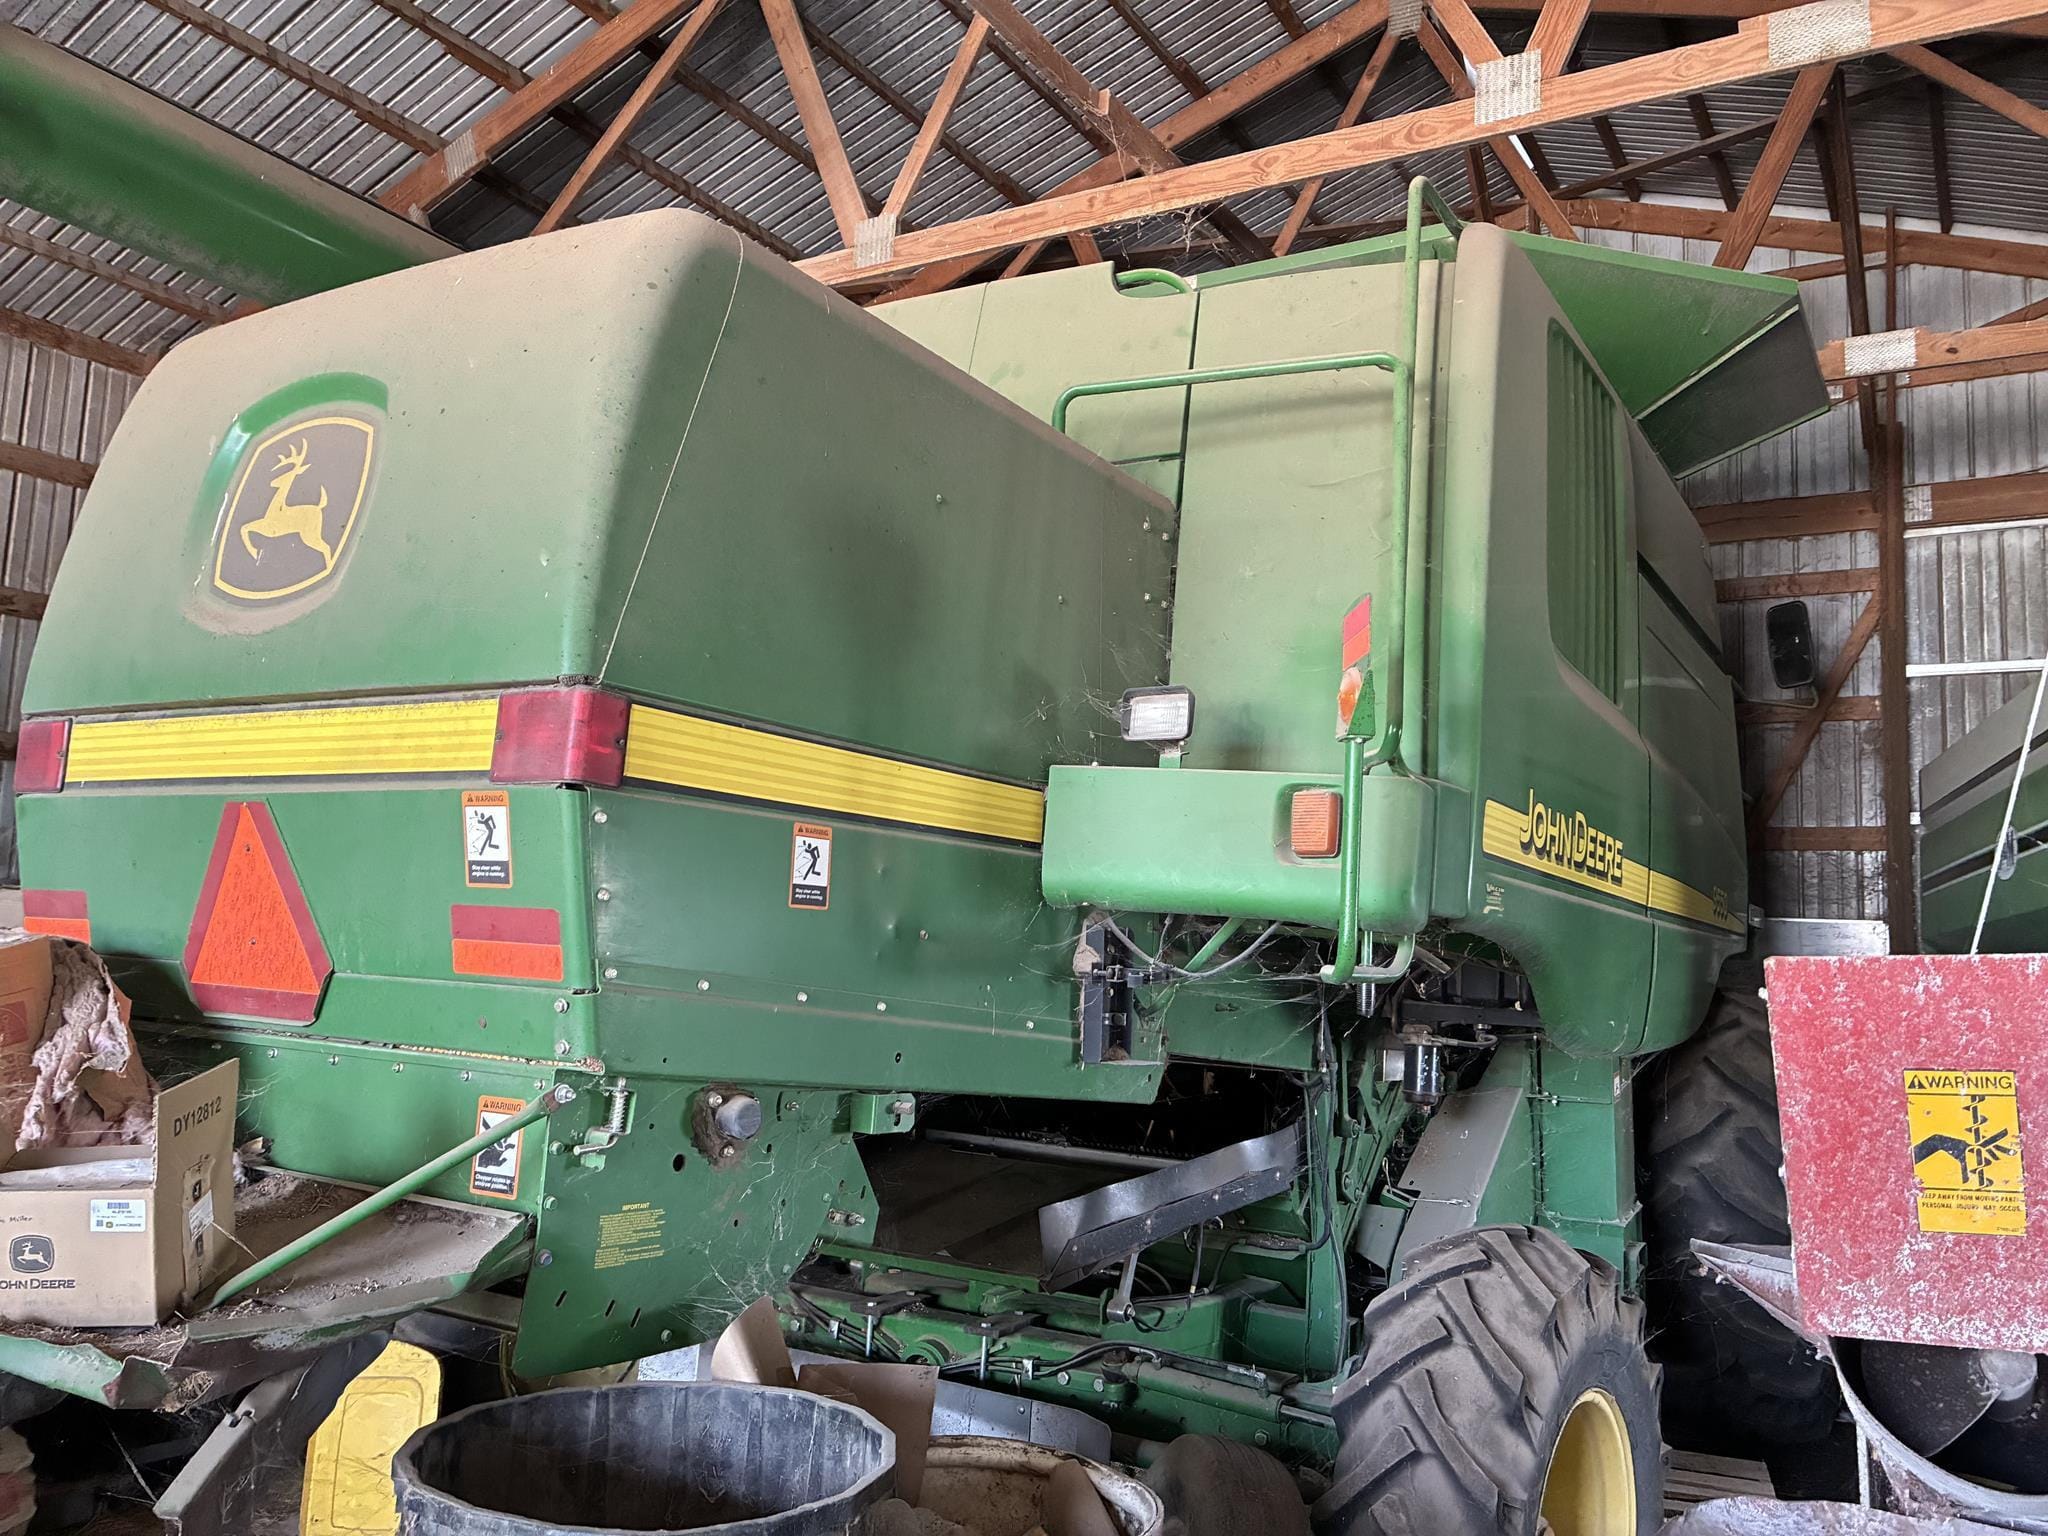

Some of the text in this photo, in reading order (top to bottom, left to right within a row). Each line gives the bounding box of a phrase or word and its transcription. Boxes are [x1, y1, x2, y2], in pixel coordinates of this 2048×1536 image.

[475, 794, 504, 802] WARNING
[1520, 787, 1624, 887] JOHN DEERE
[1924, 1075, 2013, 1090] WARNING
[489, 1100, 521, 1112] WARNING
[173, 1096, 222, 1137] DY12812
[0, 1278, 76, 1290] OHN DEERE
